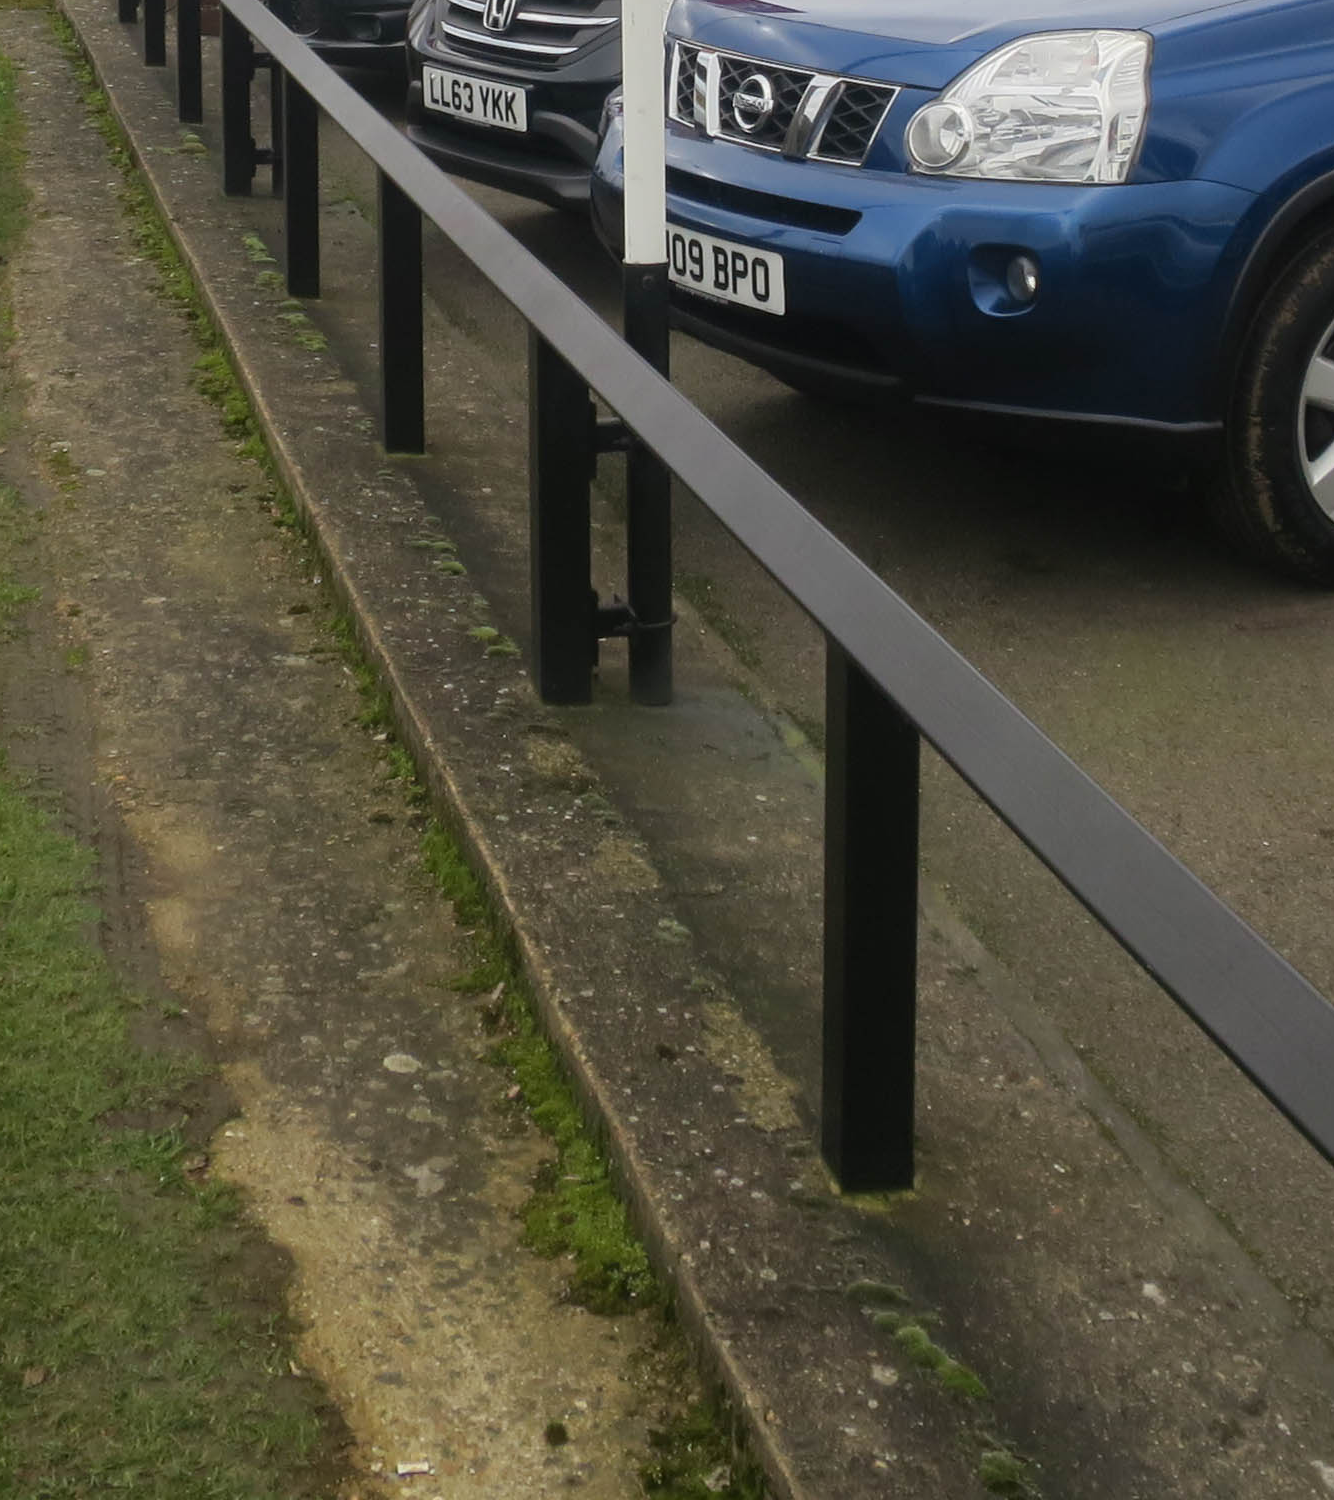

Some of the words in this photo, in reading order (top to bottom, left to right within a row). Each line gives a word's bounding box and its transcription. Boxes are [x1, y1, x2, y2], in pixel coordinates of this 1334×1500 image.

[430, 73, 473, 113] LL63
[479, 85, 517, 124] YKK
[712, 244, 770, 302] BPO
